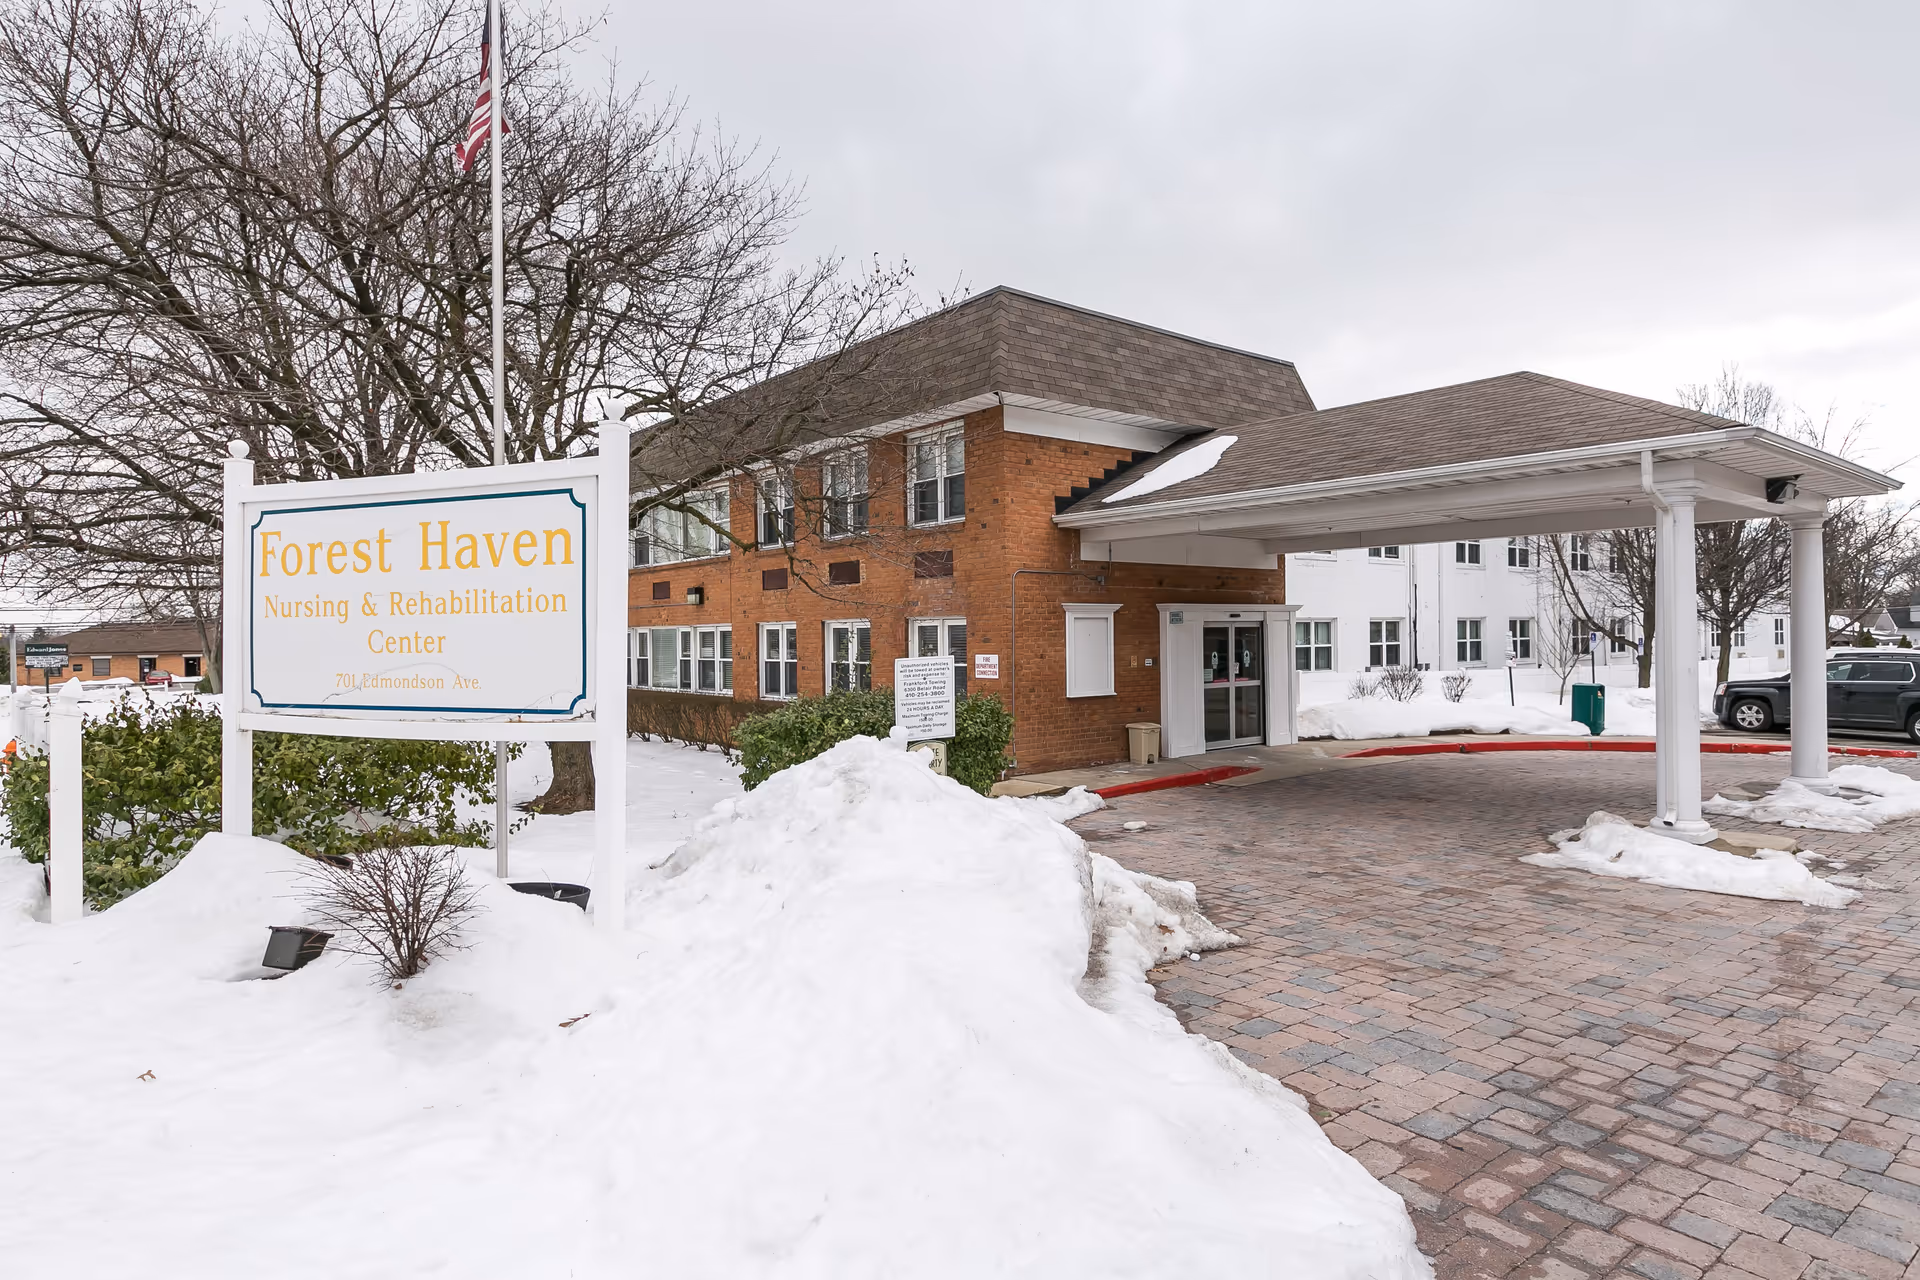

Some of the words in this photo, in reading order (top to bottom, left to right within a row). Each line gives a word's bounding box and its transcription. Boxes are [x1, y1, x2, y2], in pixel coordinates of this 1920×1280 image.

[259, 527, 392, 577] Forest
[418, 520, 575, 571] Haven
[264, 594, 349, 624] Nursing
[361, 591, 378, 617] &
[389, 587, 568, 616] Rehabilitation
[367, 629, 446, 654] Center
[335, 673, 357, 689] 701
[362, 673, 444, 690] Edmondson
[452, 674, 482, 690] Ave.
